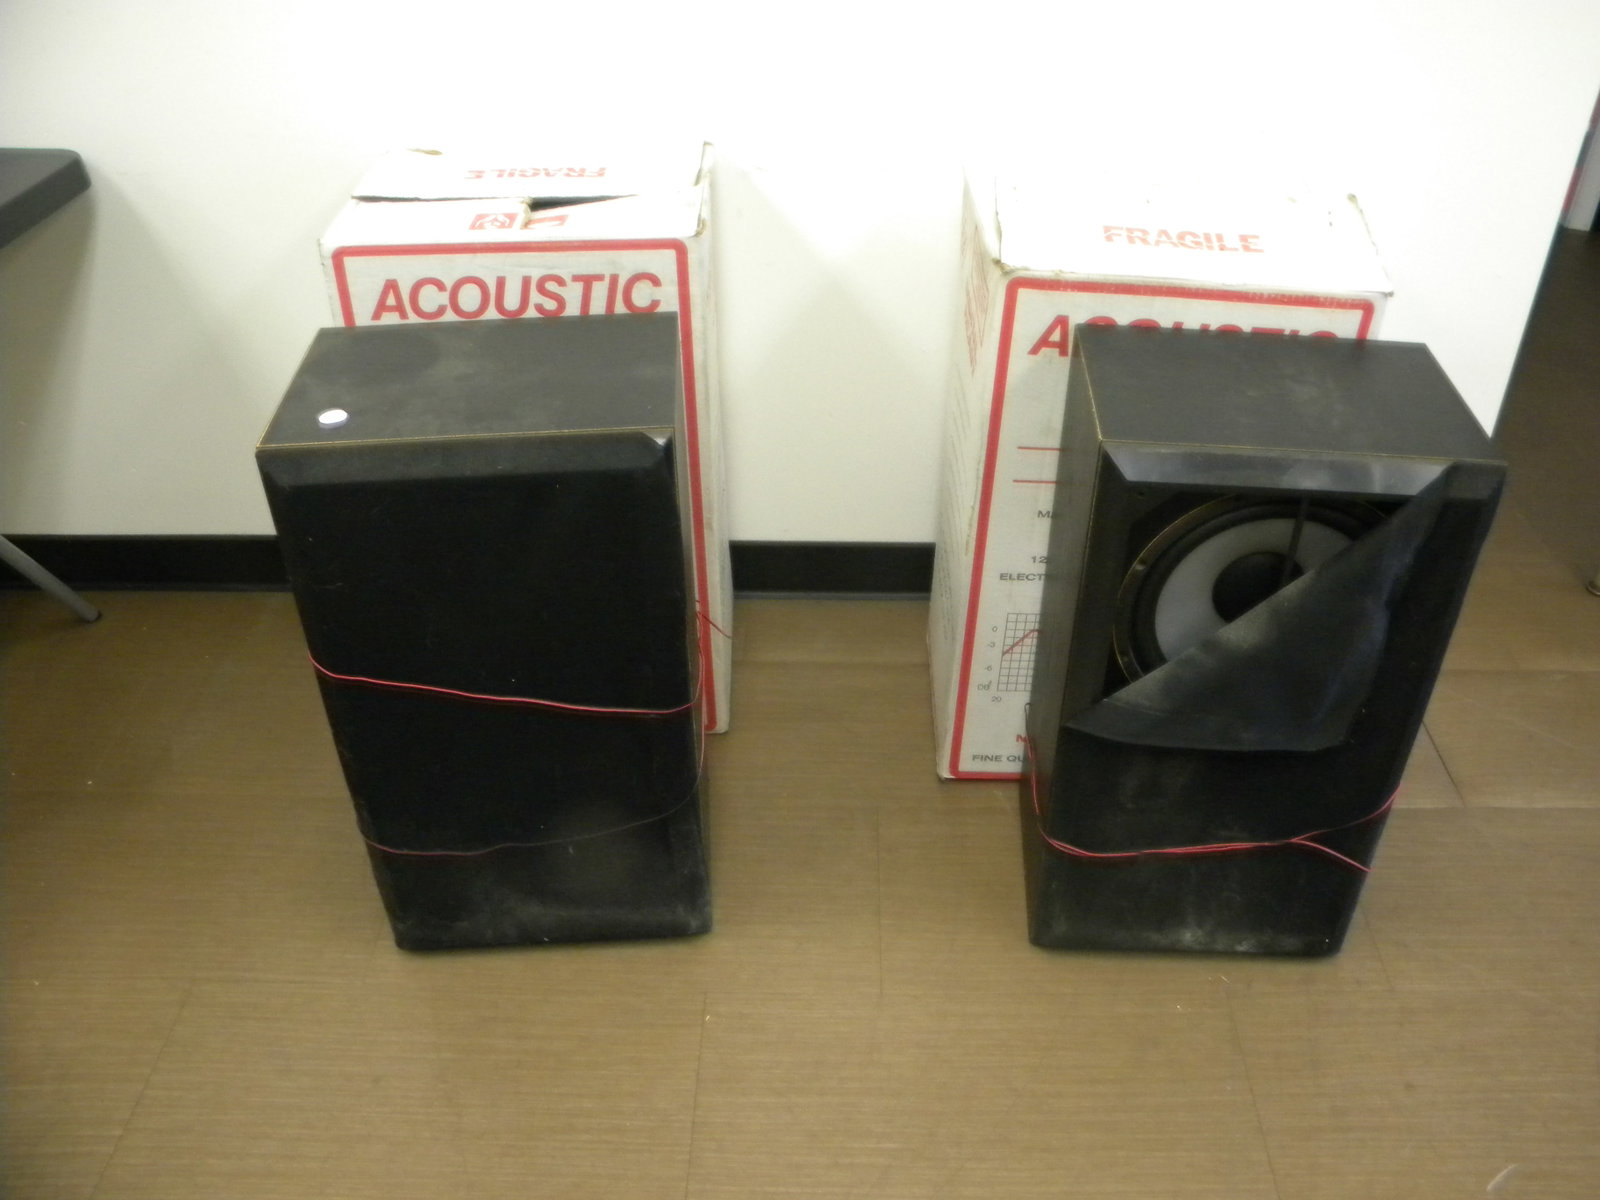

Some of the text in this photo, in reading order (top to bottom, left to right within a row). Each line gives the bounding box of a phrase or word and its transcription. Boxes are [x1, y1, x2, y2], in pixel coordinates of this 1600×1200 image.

[464, 167, 608, 180] FRAGILE
[1102, 226, 1264, 253] FRAGILE
[371, 272, 663, 321] ACOUSTIC
[972, 754, 1002, 762] FINE
